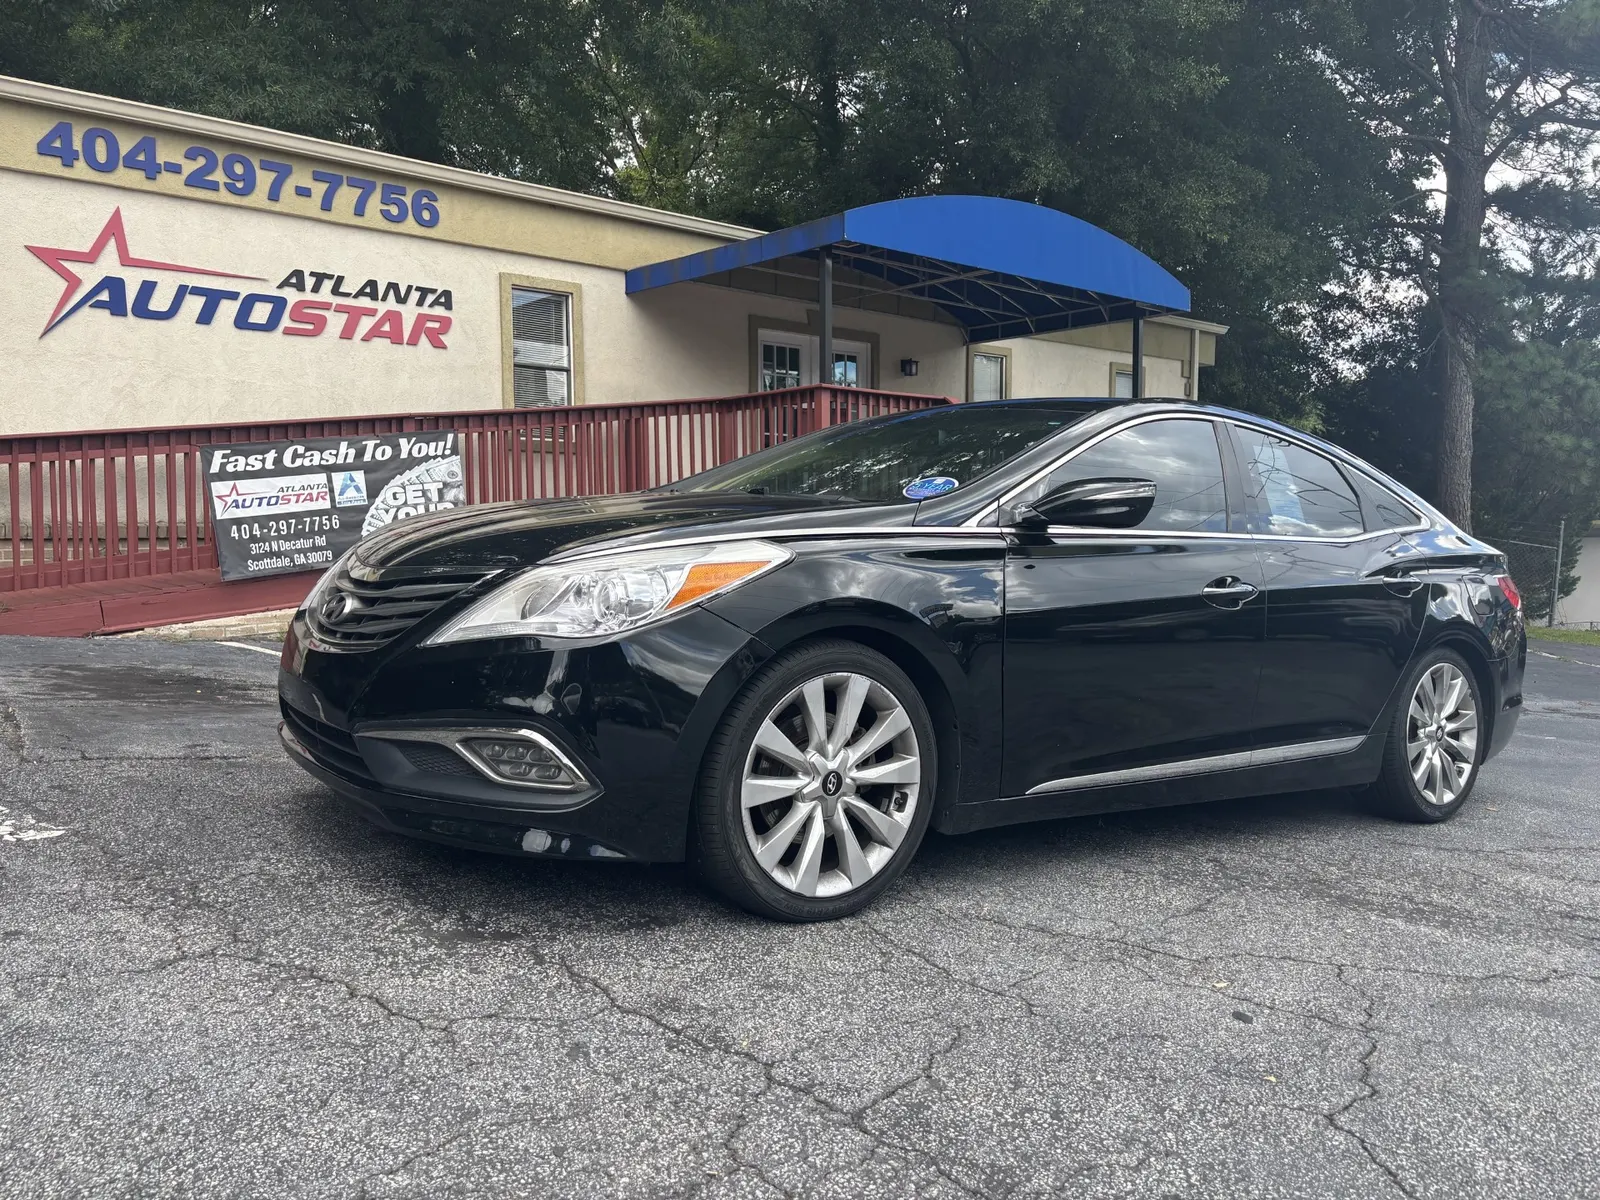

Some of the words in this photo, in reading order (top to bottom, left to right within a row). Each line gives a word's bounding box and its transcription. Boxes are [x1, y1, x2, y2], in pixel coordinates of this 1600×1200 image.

[36, 121, 441, 228] 404-297-7756
[276, 269, 454, 311] ATLANTA
[209, 449, 278, 474] Fast
[282, 441, 356, 468] Cash
[362, 439, 393, 462] To
[398, 433, 454, 459] You!
[277, 482, 329, 494] ATLANTA
[385, 482, 443, 506] GET
[230, 514, 340, 541] 404-297-7756
[249, 541, 271, 555] 3124
[271, 540, 279, 552] N
[279, 538, 313, 552] Decatur
[315, 535, 327, 547] Rd
[247, 556, 294, 571] Scottdale,
[294, 552, 306, 565] GA
[307, 550, 333, 563] 30079
